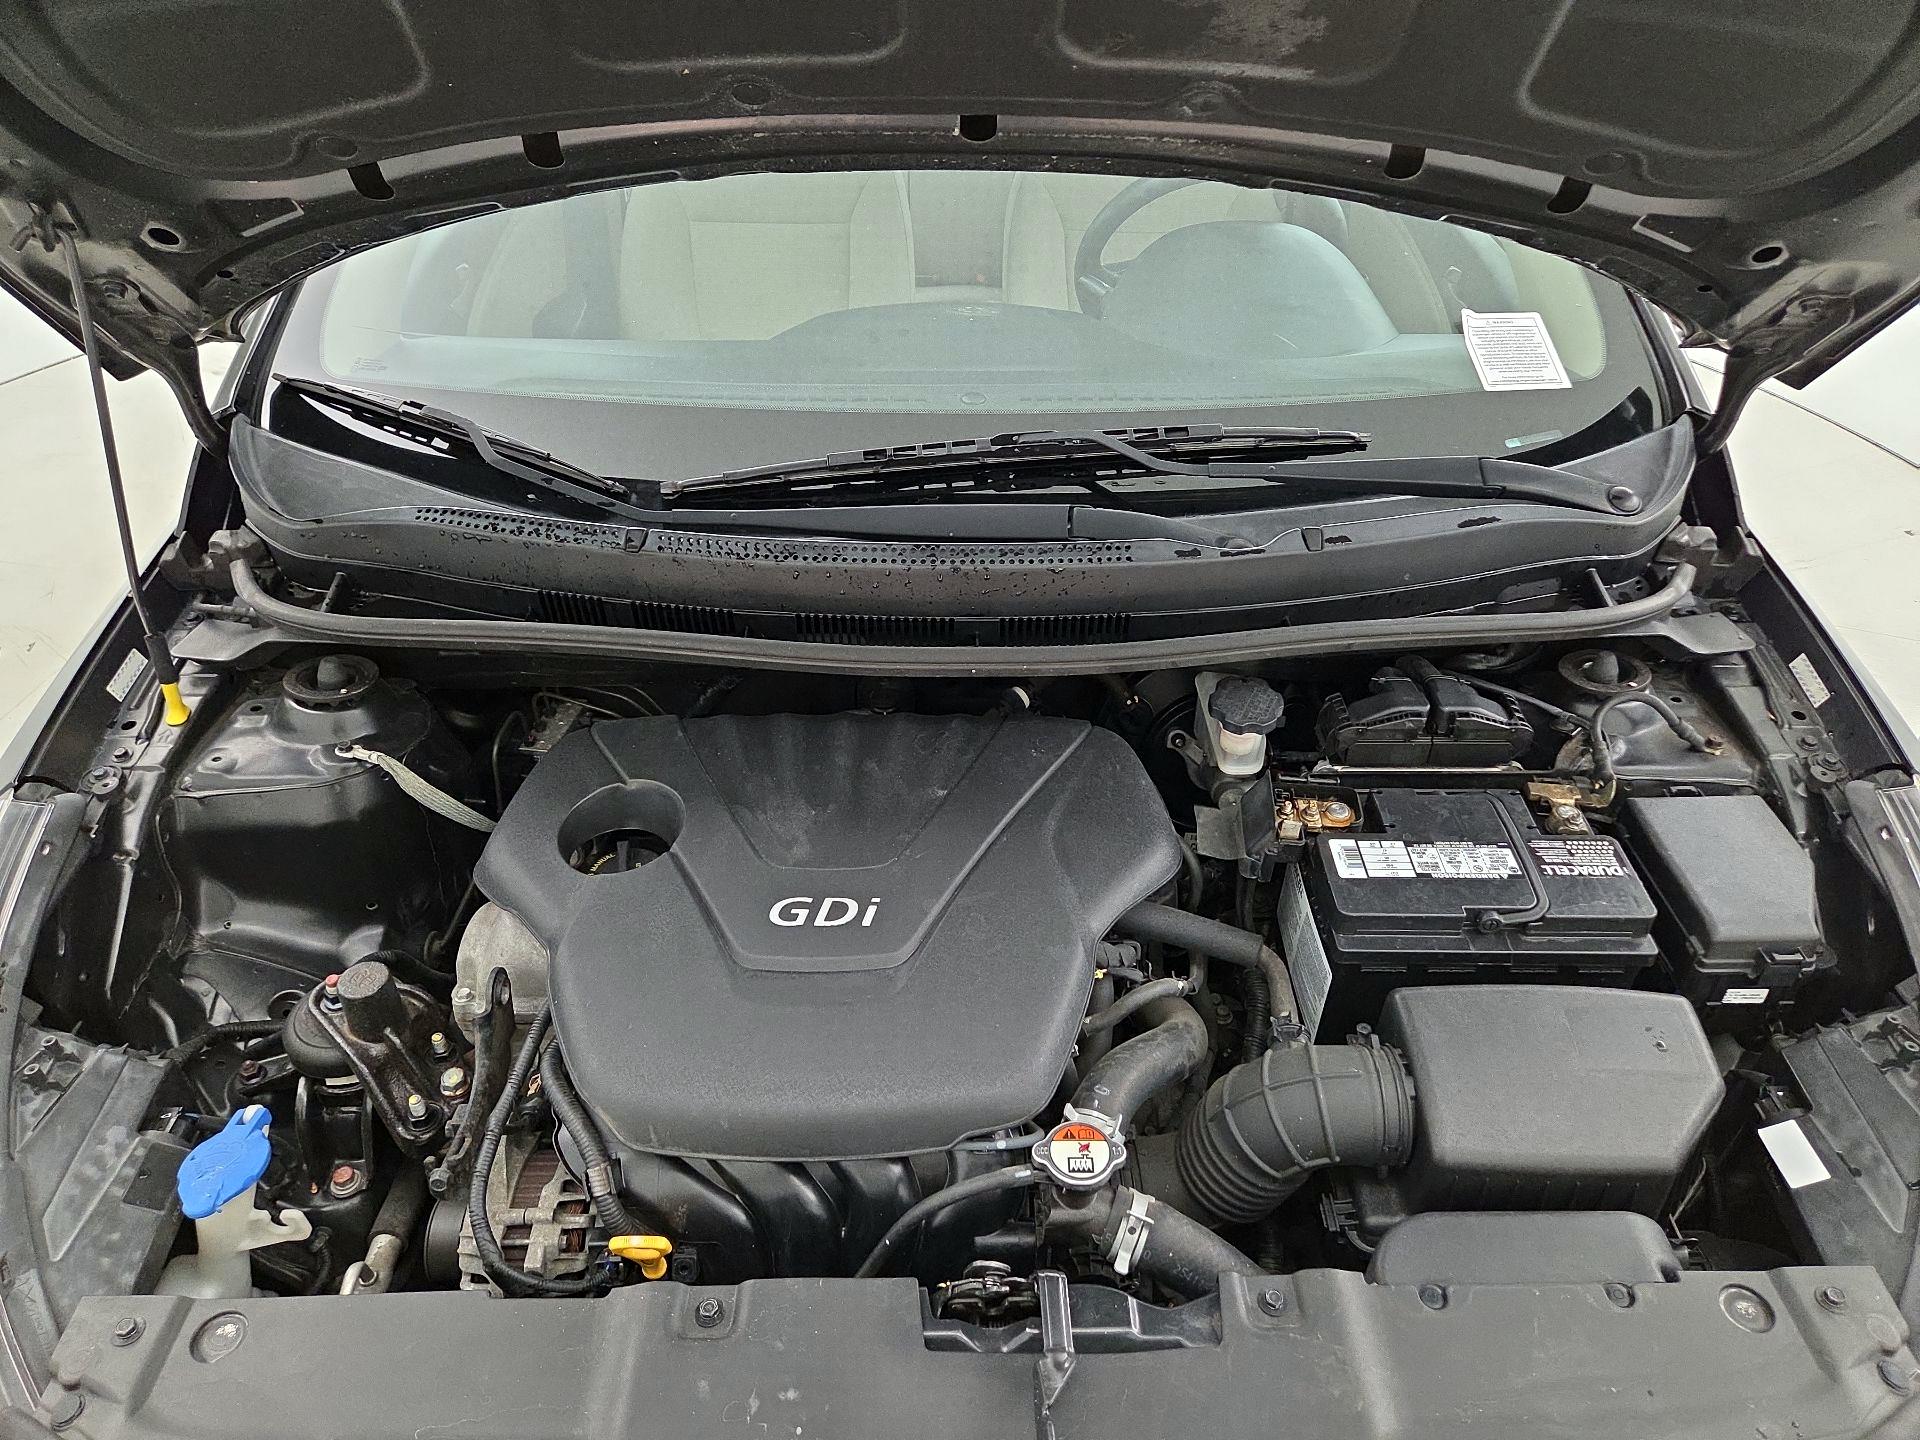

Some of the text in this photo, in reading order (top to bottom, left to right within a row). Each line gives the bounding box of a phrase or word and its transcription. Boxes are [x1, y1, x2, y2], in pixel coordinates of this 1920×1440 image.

[590, 853, 616, 872] MANUAL
[1541, 865, 1624, 877] DURACELL
[769, 896, 881, 927] GDi
